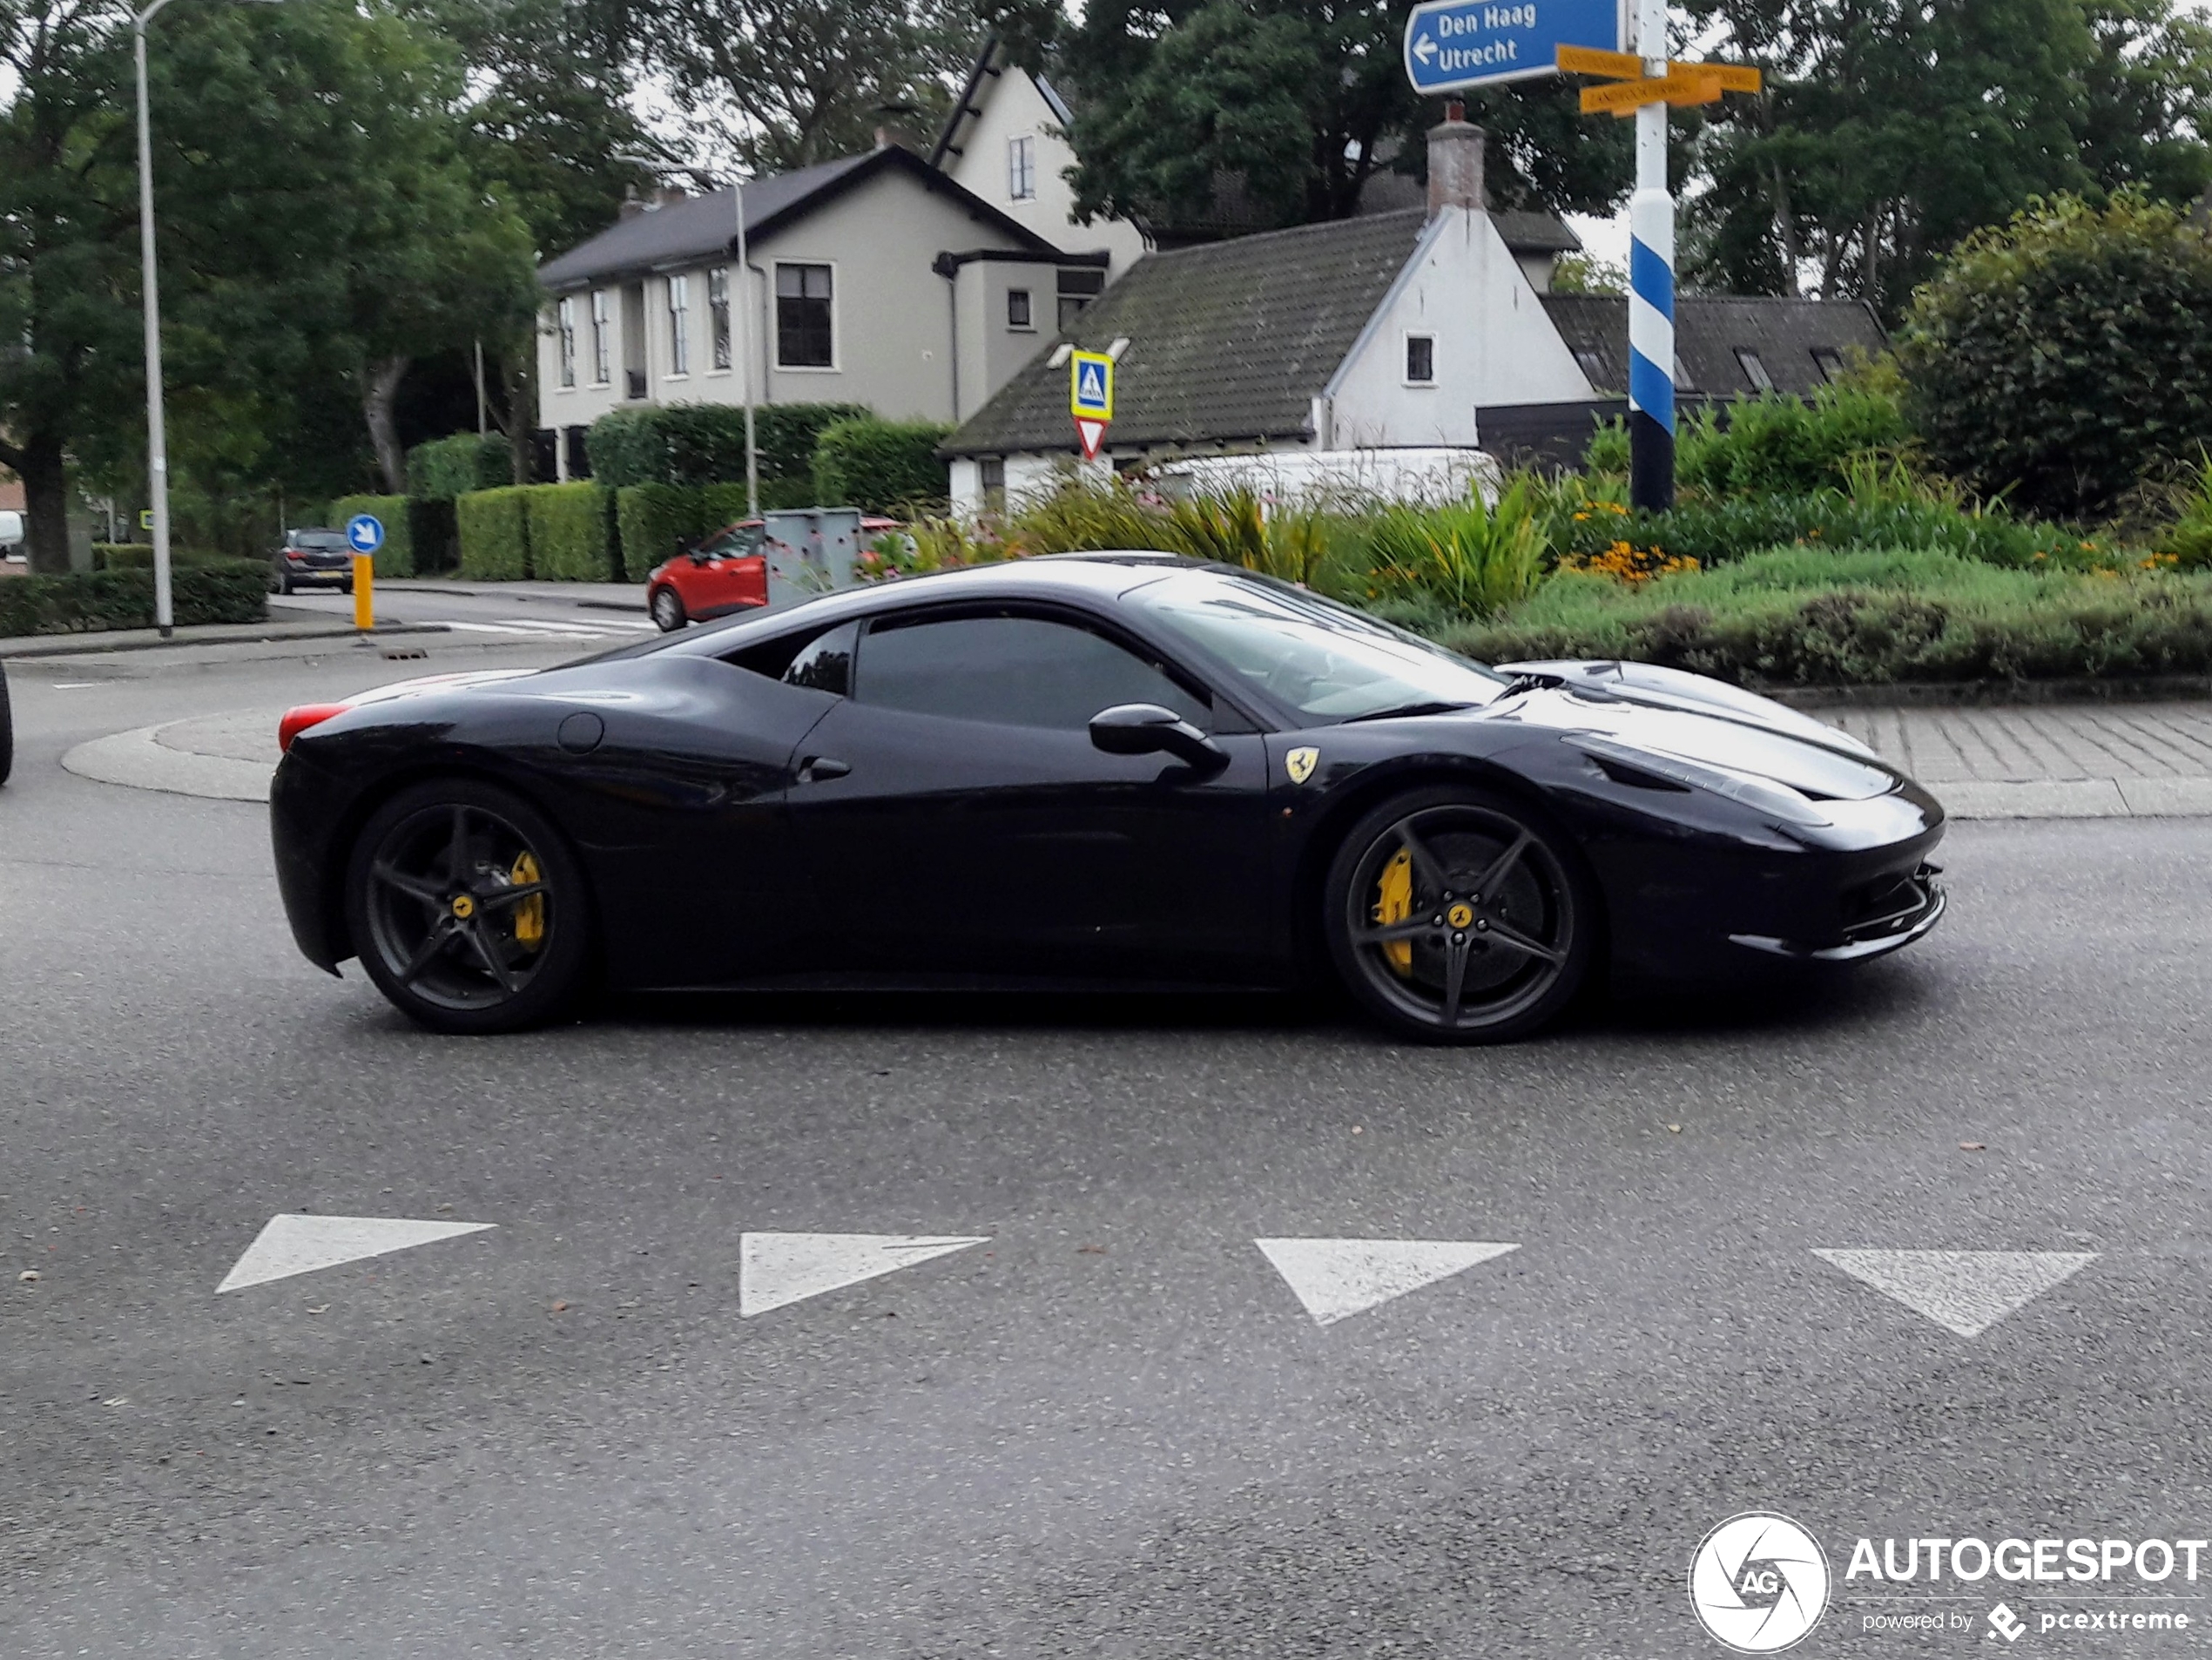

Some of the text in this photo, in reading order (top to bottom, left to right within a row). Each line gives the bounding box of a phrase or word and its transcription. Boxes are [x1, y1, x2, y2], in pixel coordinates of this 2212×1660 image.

[1439, 3, 1536, 38] Den Haag
[1439, 38, 1518, 72] Utrecht
